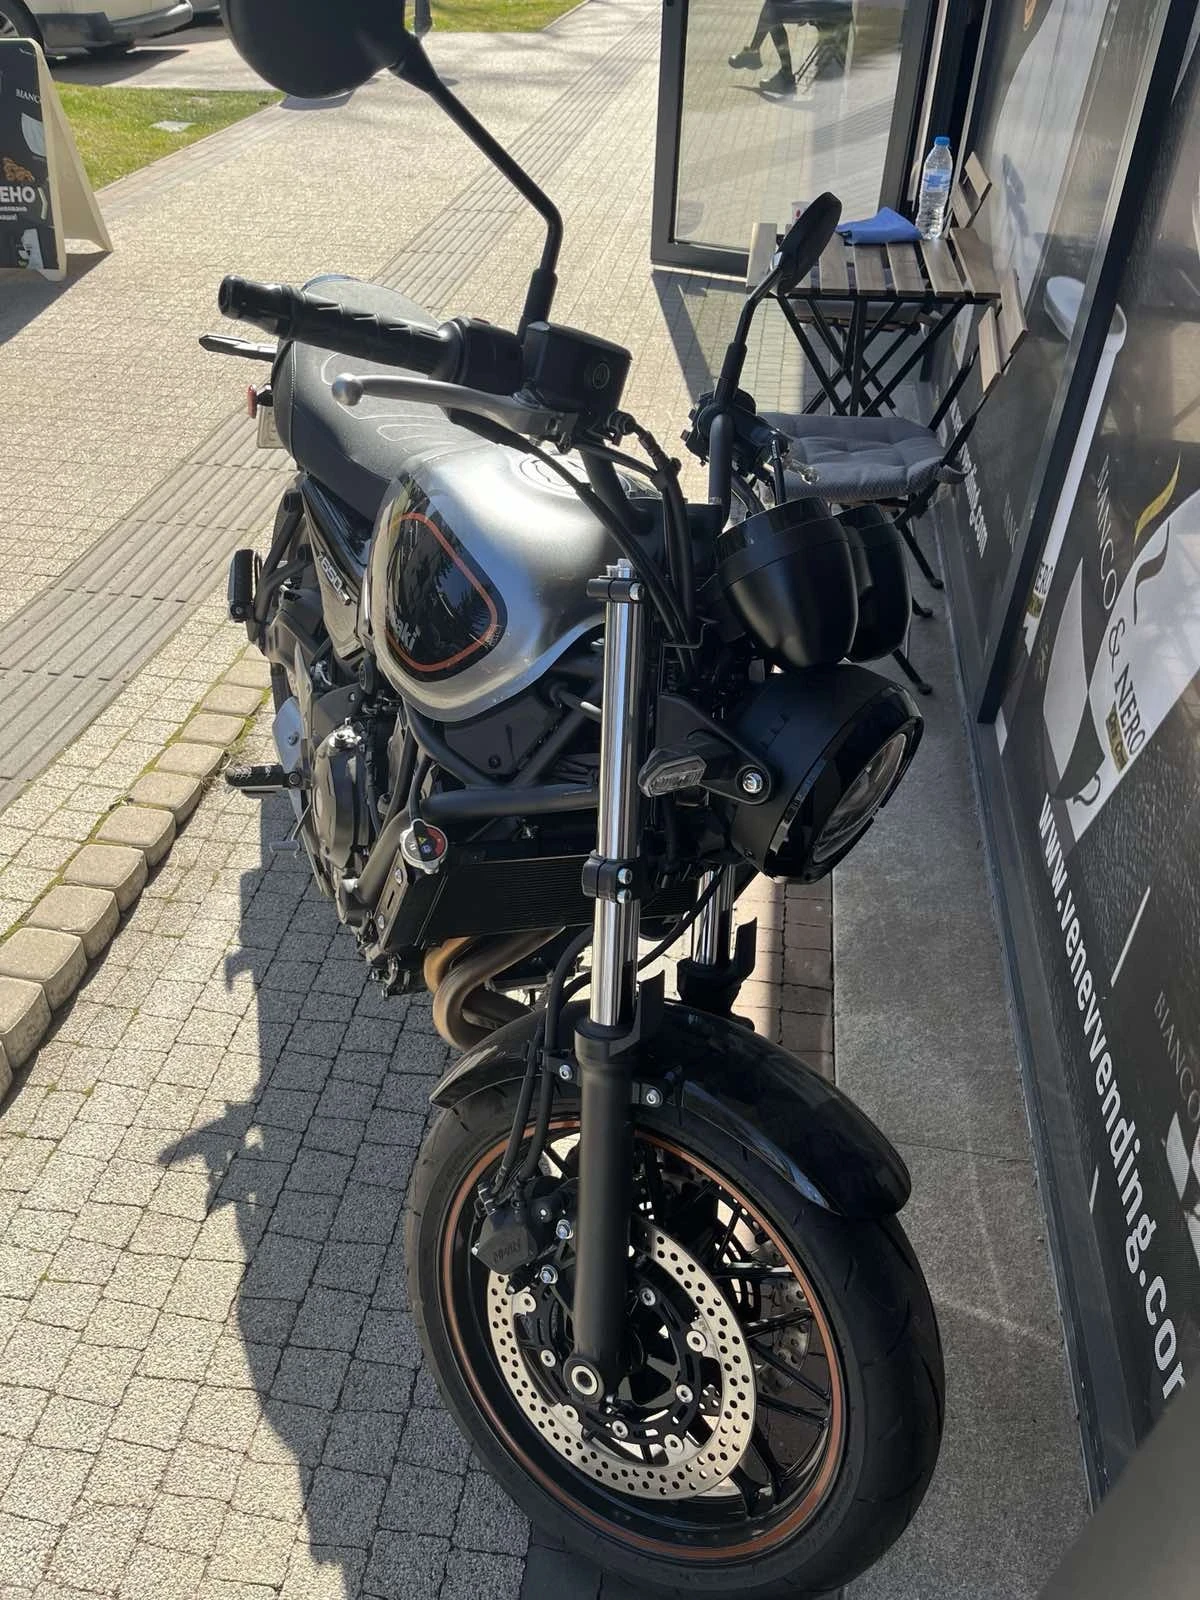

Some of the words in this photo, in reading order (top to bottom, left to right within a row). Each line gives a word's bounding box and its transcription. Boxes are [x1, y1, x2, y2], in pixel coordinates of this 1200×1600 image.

[1097, 453, 1118, 611] BIANCO
[1108, 617, 1125, 674] &
[1114, 662, 1146, 756] NERO
[1154, 990, 1200, 1123] BIANCO
